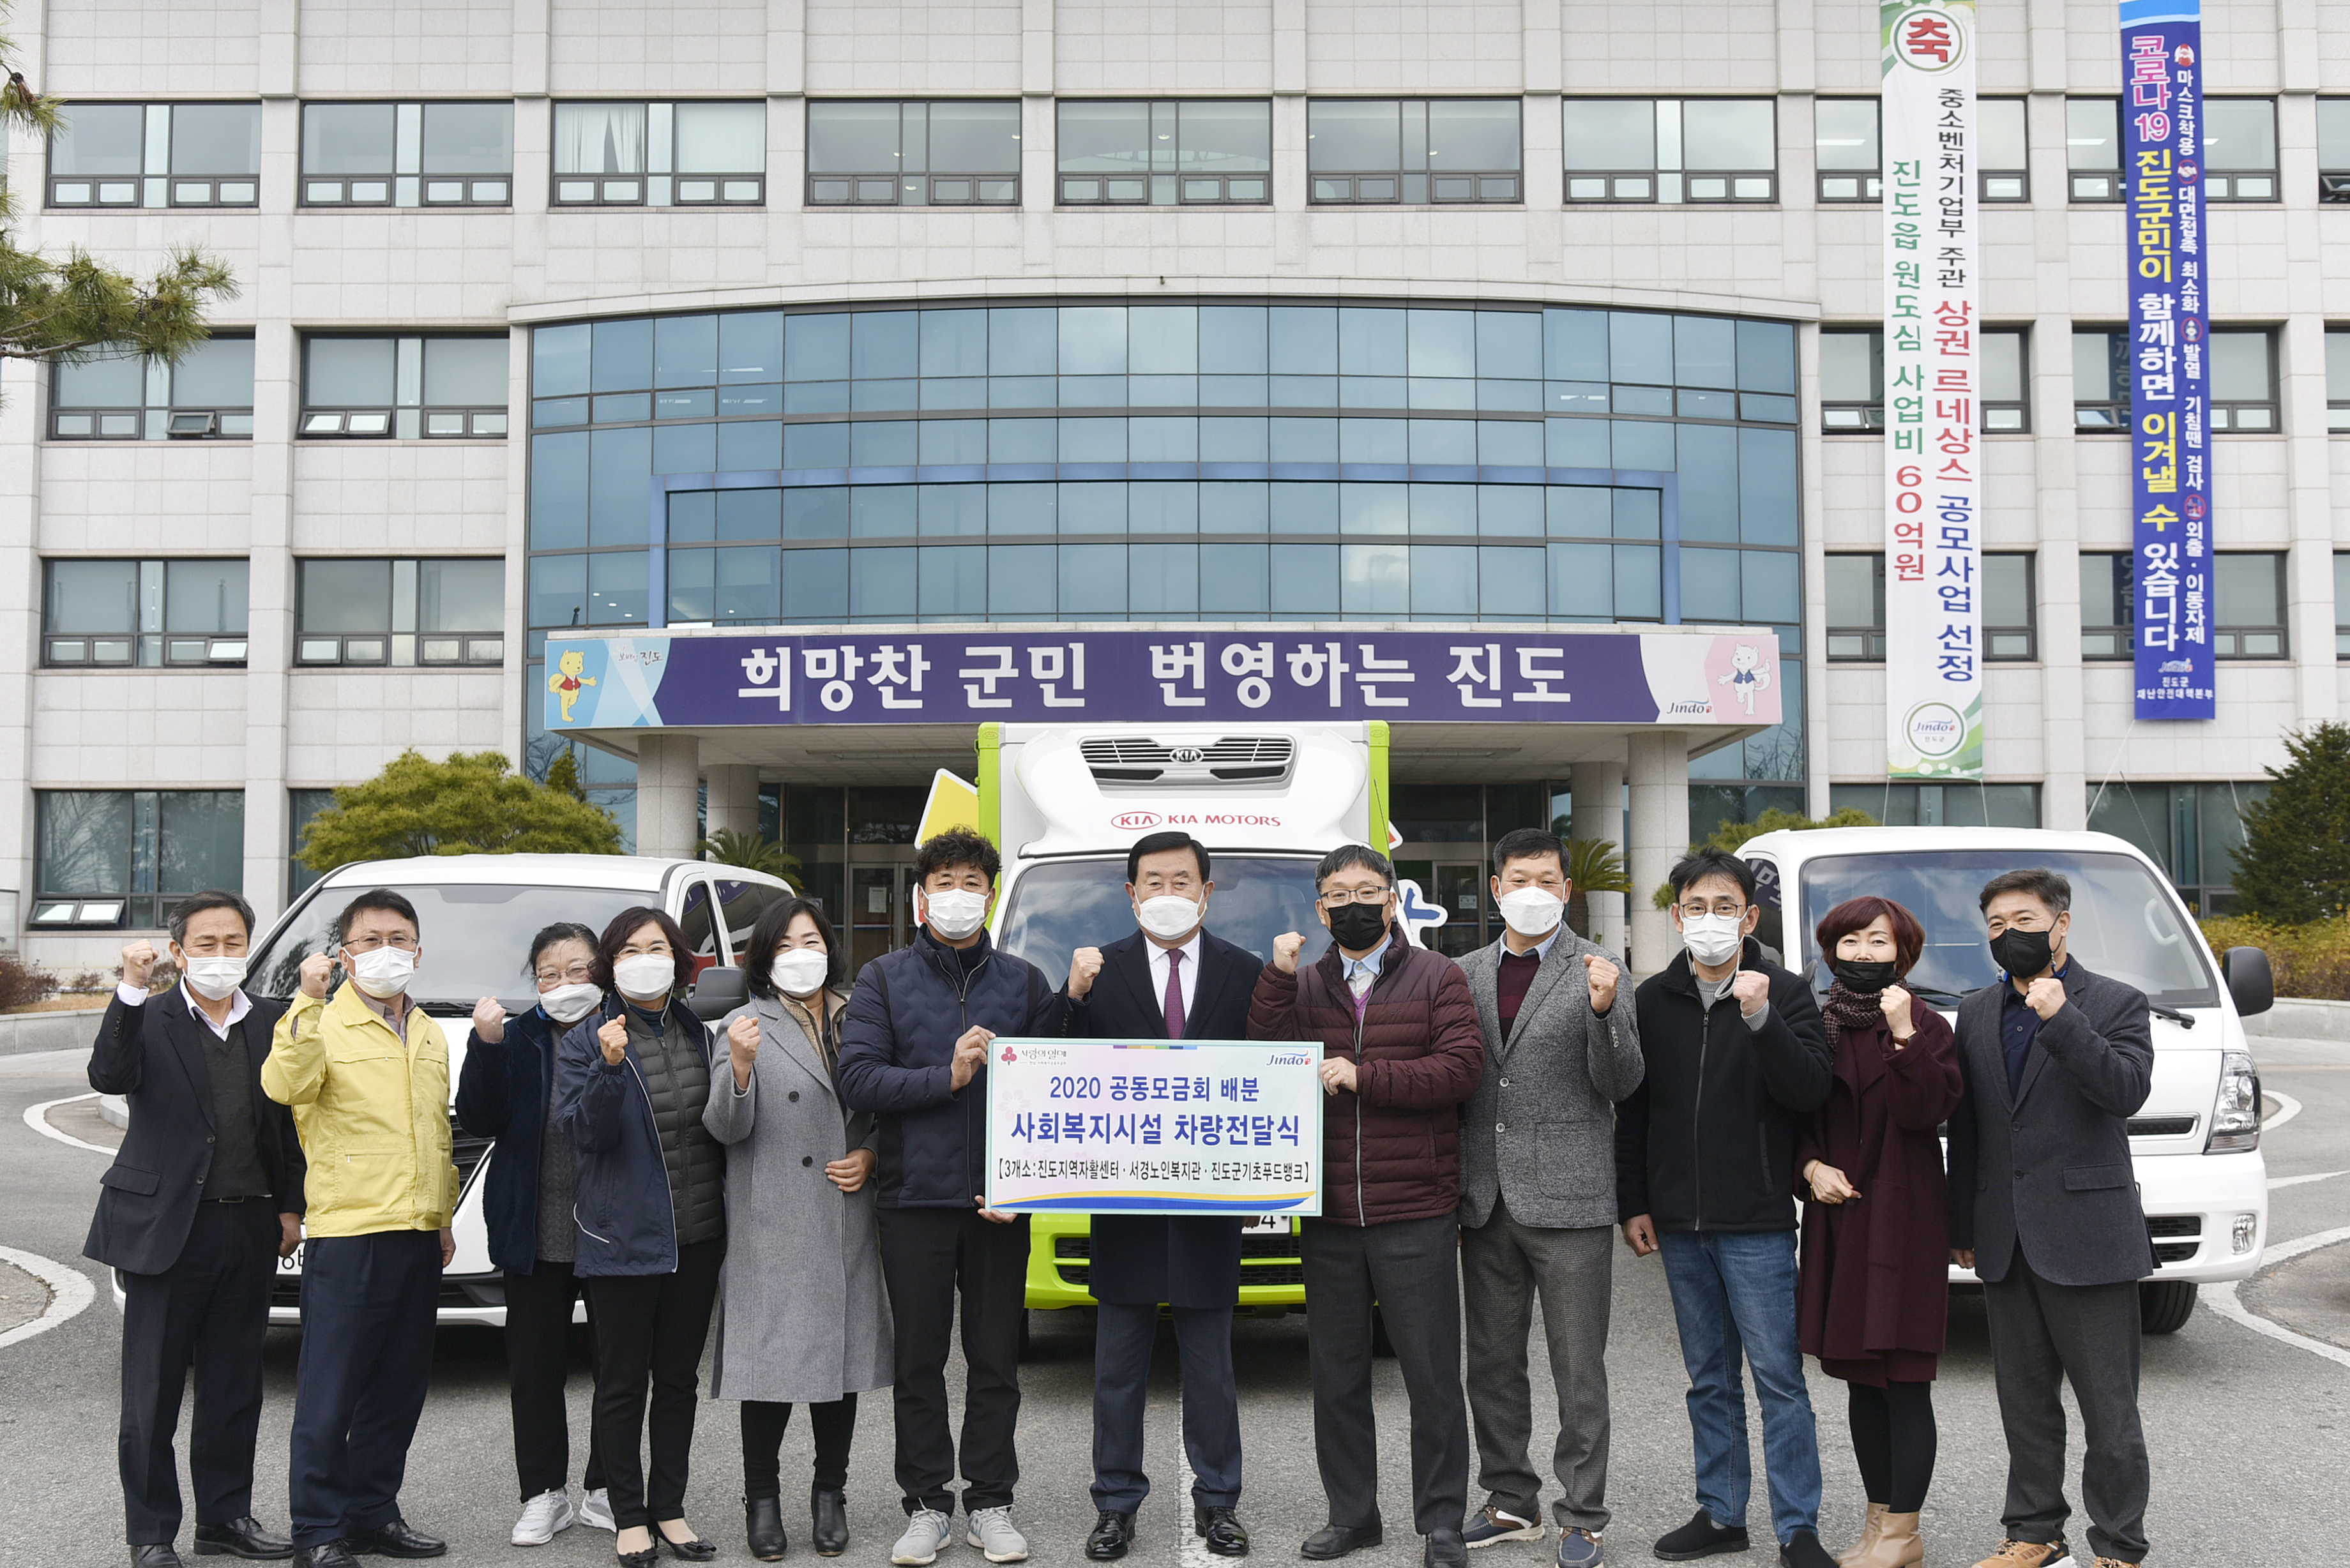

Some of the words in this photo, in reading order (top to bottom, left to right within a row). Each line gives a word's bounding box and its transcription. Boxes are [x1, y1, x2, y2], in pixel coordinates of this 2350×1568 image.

[1906, 18, 1952, 63] 축
[2177, 69, 2195, 156] 마스크착용
[1937, 88, 1966, 238] 중소벤처기업부
[1891, 160, 1922, 250] 진도읍
[2135, 149, 2173, 282] 진도군민이
[2178, 185, 2198, 255] 대면접촉
[1937, 247, 1966, 288] 주관
[2180, 261, 2201, 313] 최소화
[1892, 260, 1922, 351] 원도심
[1934, 301, 1973, 356] 상권
[2138, 294, 2178, 401] 함께하면
[1892, 364, 1925, 455] 사업비
[1934, 369, 1974, 482] 르네상스
[2142, 411, 2178, 494] 이겨낼
[2185, 455, 2204, 491] 검사
[2141, 504, 2179, 532] 수
[1936, 495, 1974, 614] 공모사업
[2142, 542, 2180, 652] 있습니다
[640, 651, 664, 666] 진도
[738, 644, 931, 712] 희망찬
[959, 642, 1085, 709] 군민
[1149, 642, 1415, 709] 번영하는
[1446, 644, 1571, 708] 진도
[1936, 624, 1973, 682] 선정
[1667, 702, 1704, 714] Jindo
[2137, 688, 2213, 700] 재난안전대책본부
[2162, 676, 2189, 688] 진도군
[1175, 750, 1199, 761] KIA
[1120, 815, 1154, 826] KIA
[1169, 815, 1199, 824] KIA
[1206, 815, 1281, 827] MOTORS
[1266, 1054, 1304, 1066] Jindo
[1050, 1076, 1101, 1099] 2020
[1110, 1076, 1211, 1102] 공동모금회
[1221, 1077, 1260, 1103] 배분
[1012, 1112, 1162, 1145] 사회복지시설
[1174, 1114, 1299, 1147] 차량전달식
